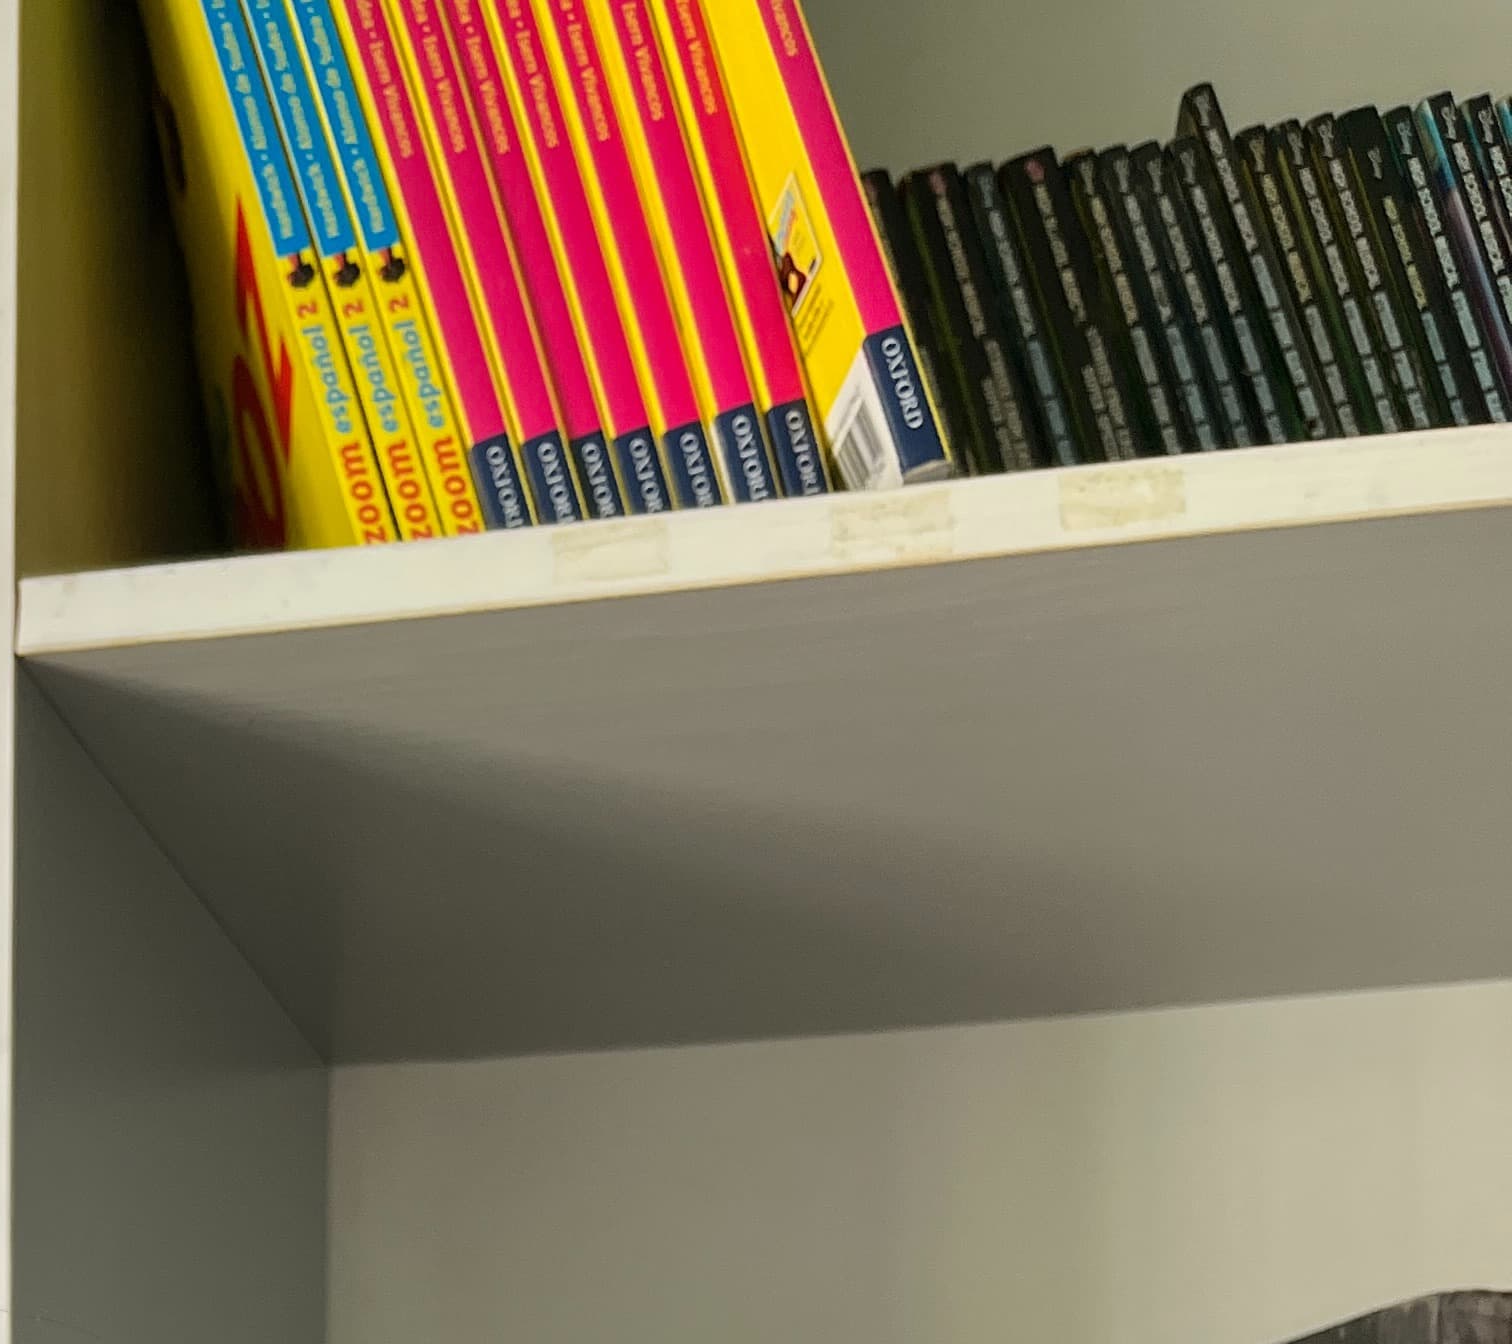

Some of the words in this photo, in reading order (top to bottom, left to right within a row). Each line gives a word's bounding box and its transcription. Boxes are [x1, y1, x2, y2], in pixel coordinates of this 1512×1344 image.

[529, 74, 559, 148] Vivancos
[581, 67, 610, 141] Vivancos
[635, 46, 664, 121] Vivancos
[689, 39, 717, 115] Vivancos
[384, 84, 413, 158] Vivancos
[438, 78, 466, 154] Vivancos
[480, 80, 510, 154] Vivancos
[296, 301, 318, 319] 2
[343, 299, 364, 318] 2
[389, 296, 409, 313] 2
[303, 325, 352, 433] español
[349, 325, 399, 432] español
[394, 320, 444, 429] español
[882, 337, 923, 429] OXFORD
[340, 440, 387, 544] zoom
[387, 440, 433, 541] zoom
[433, 436, 479, 535] zoom
[582, 442, 616, 518] OXFOR
[629, 437, 663, 512] OXFOR
